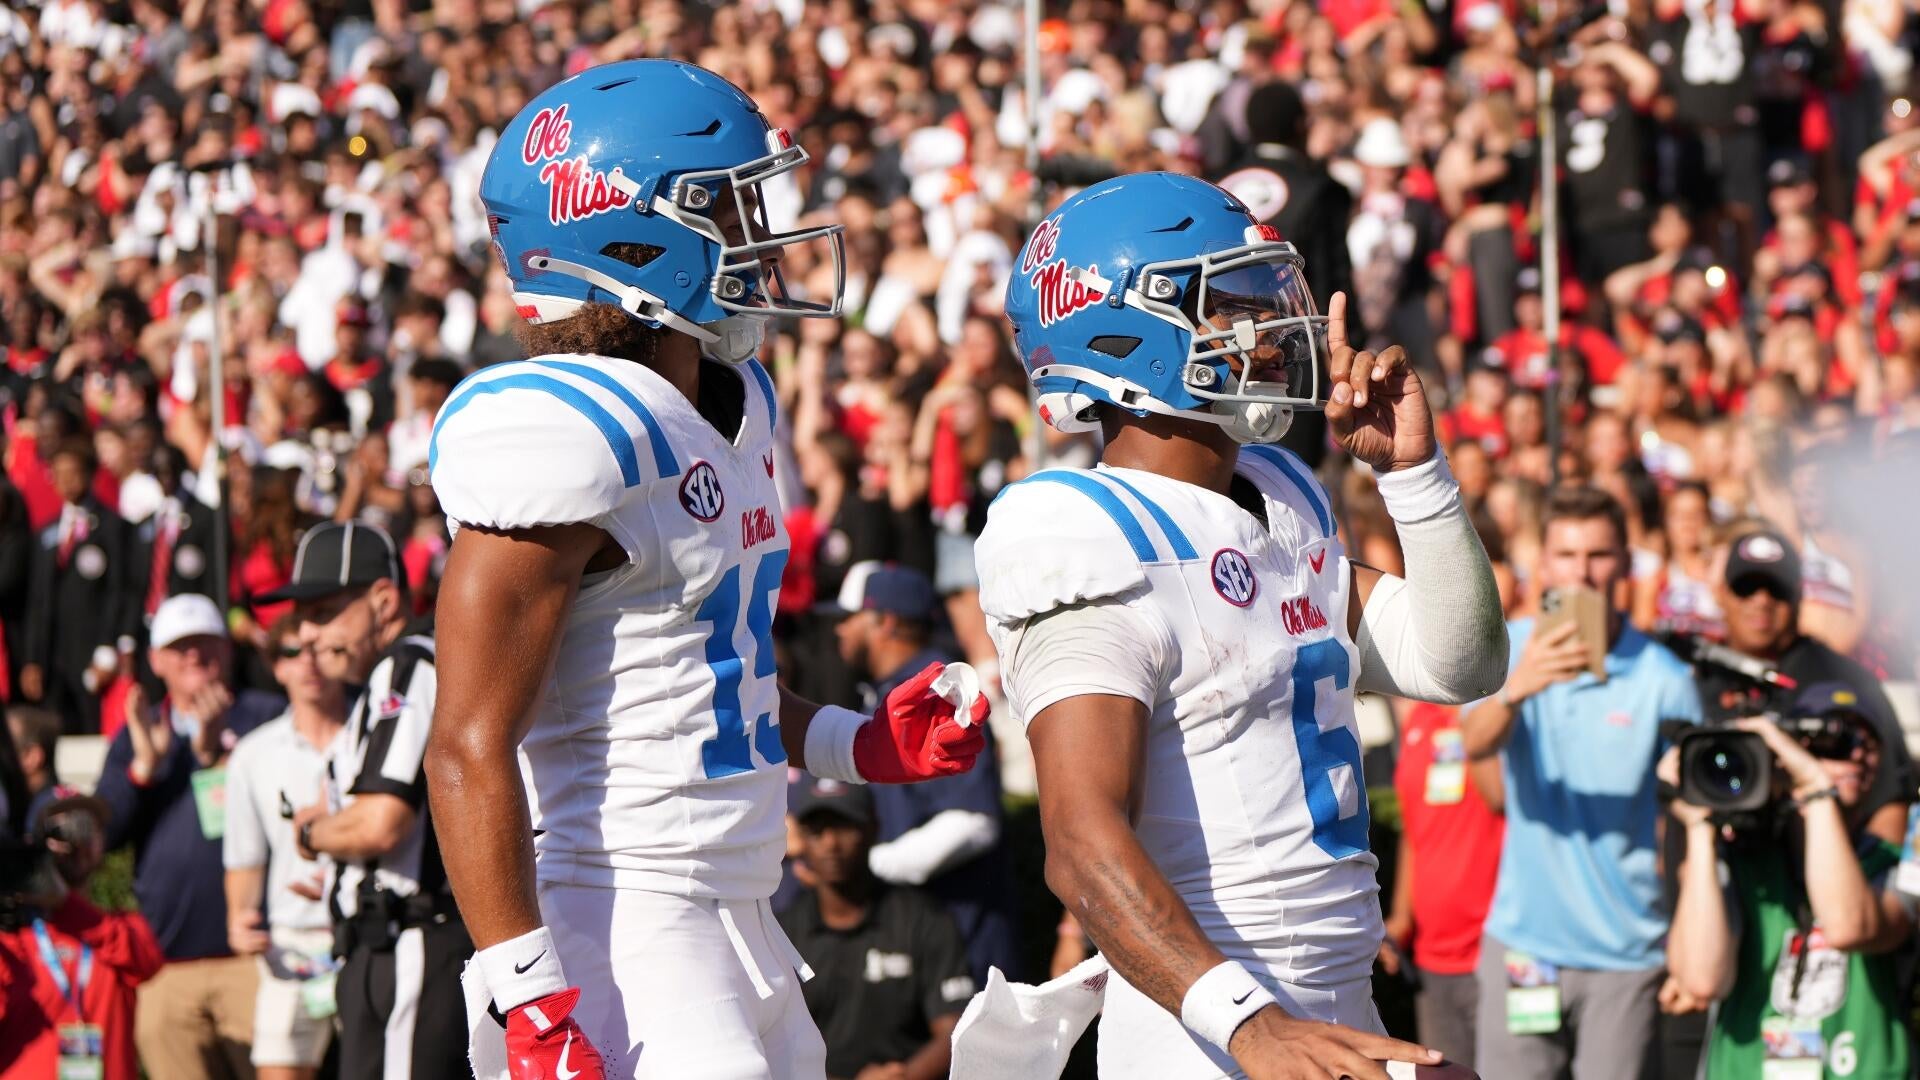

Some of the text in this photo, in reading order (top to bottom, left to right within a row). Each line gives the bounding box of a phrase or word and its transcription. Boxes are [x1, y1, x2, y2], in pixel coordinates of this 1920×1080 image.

[523, 104, 572, 165] Ole
[540, 156, 633, 226] Miss
[1022, 213, 1062, 274] Ole
[683, 464, 722, 519] SEC
[1214, 551, 1254, 603] SEC
[1281, 595, 1328, 635] Ole Miss
[1291, 636, 1370, 860] 6
